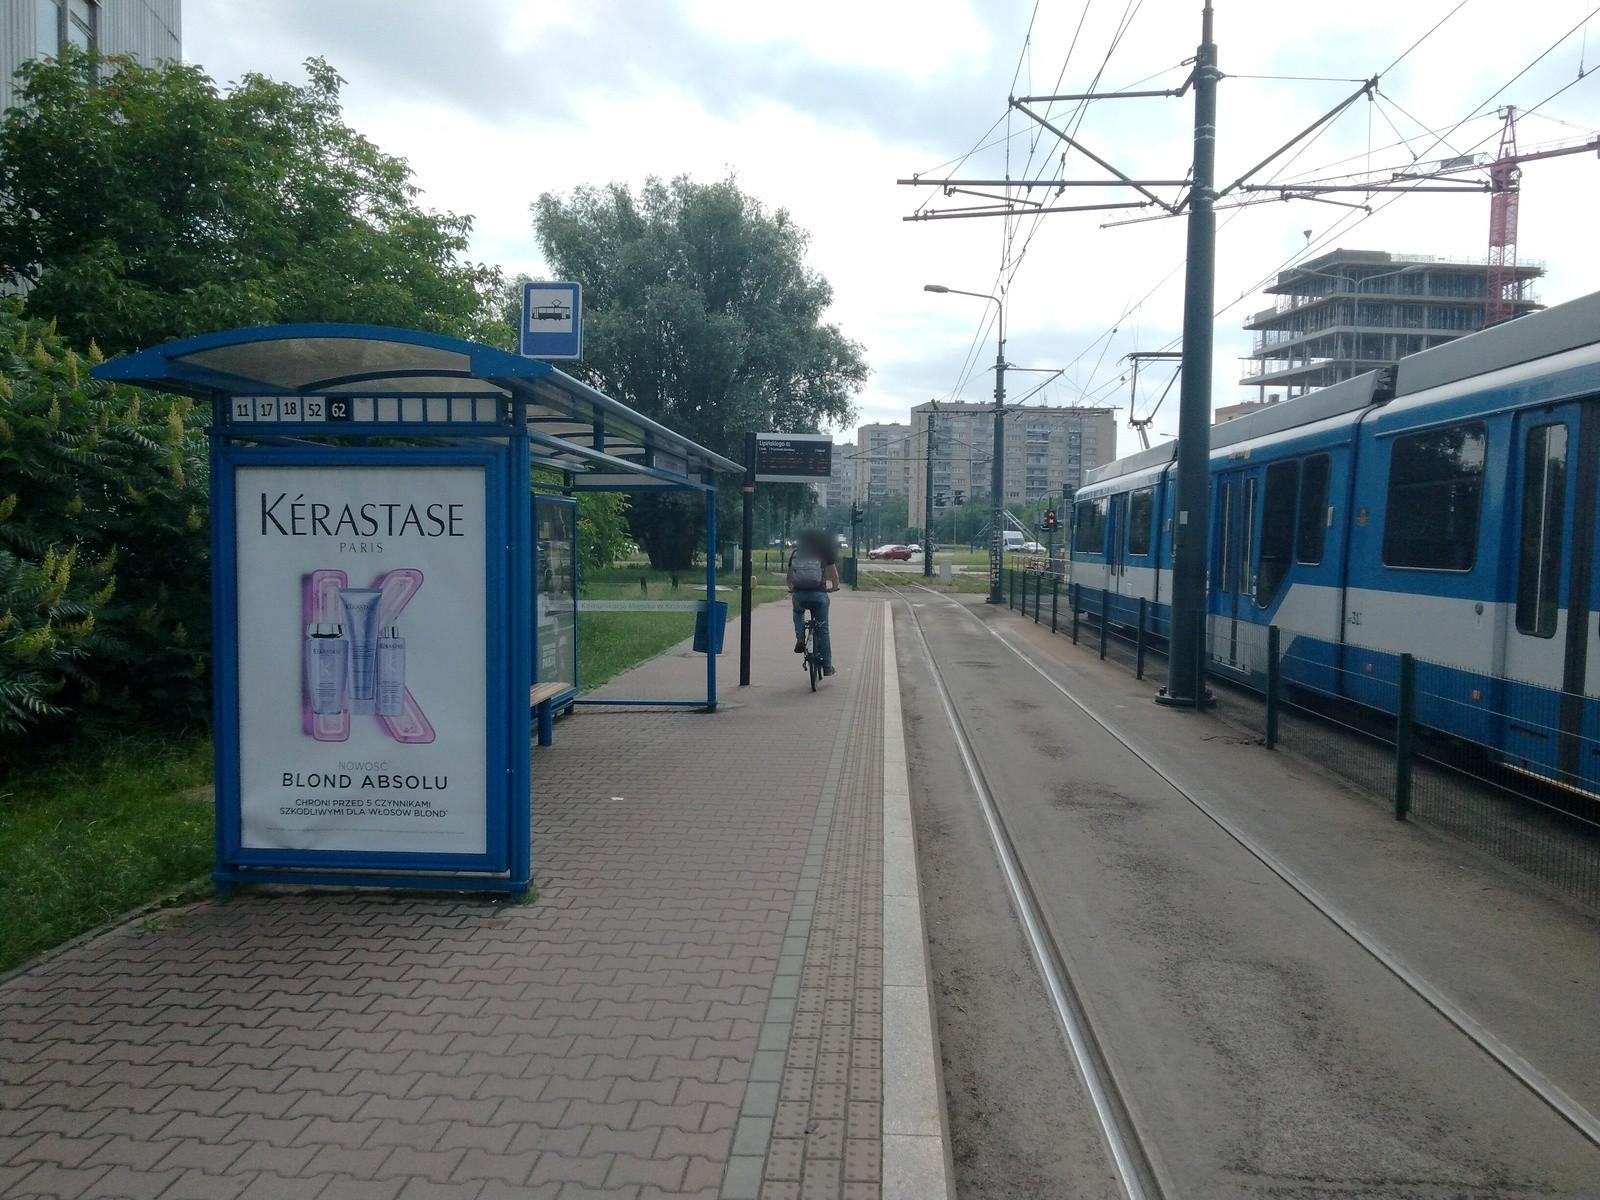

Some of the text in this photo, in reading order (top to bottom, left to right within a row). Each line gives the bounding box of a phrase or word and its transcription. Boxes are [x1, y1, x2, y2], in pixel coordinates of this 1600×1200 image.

[237, 401, 346, 417] 11 17 18 52 62
[261, 492, 464, 537] KÉRASTASE
[339, 542, 384, 553] PARIS
[282, 772, 447, 790] BLOND ABSOLU
[295, 798, 331, 807] CHRONI
[333, 799, 364, 807] PRZED
[374, 799, 431, 808] CZYNNIKAMI
[279, 807, 344, 816] SZKODLIWYMI
[346, 808, 366, 816] DLA
